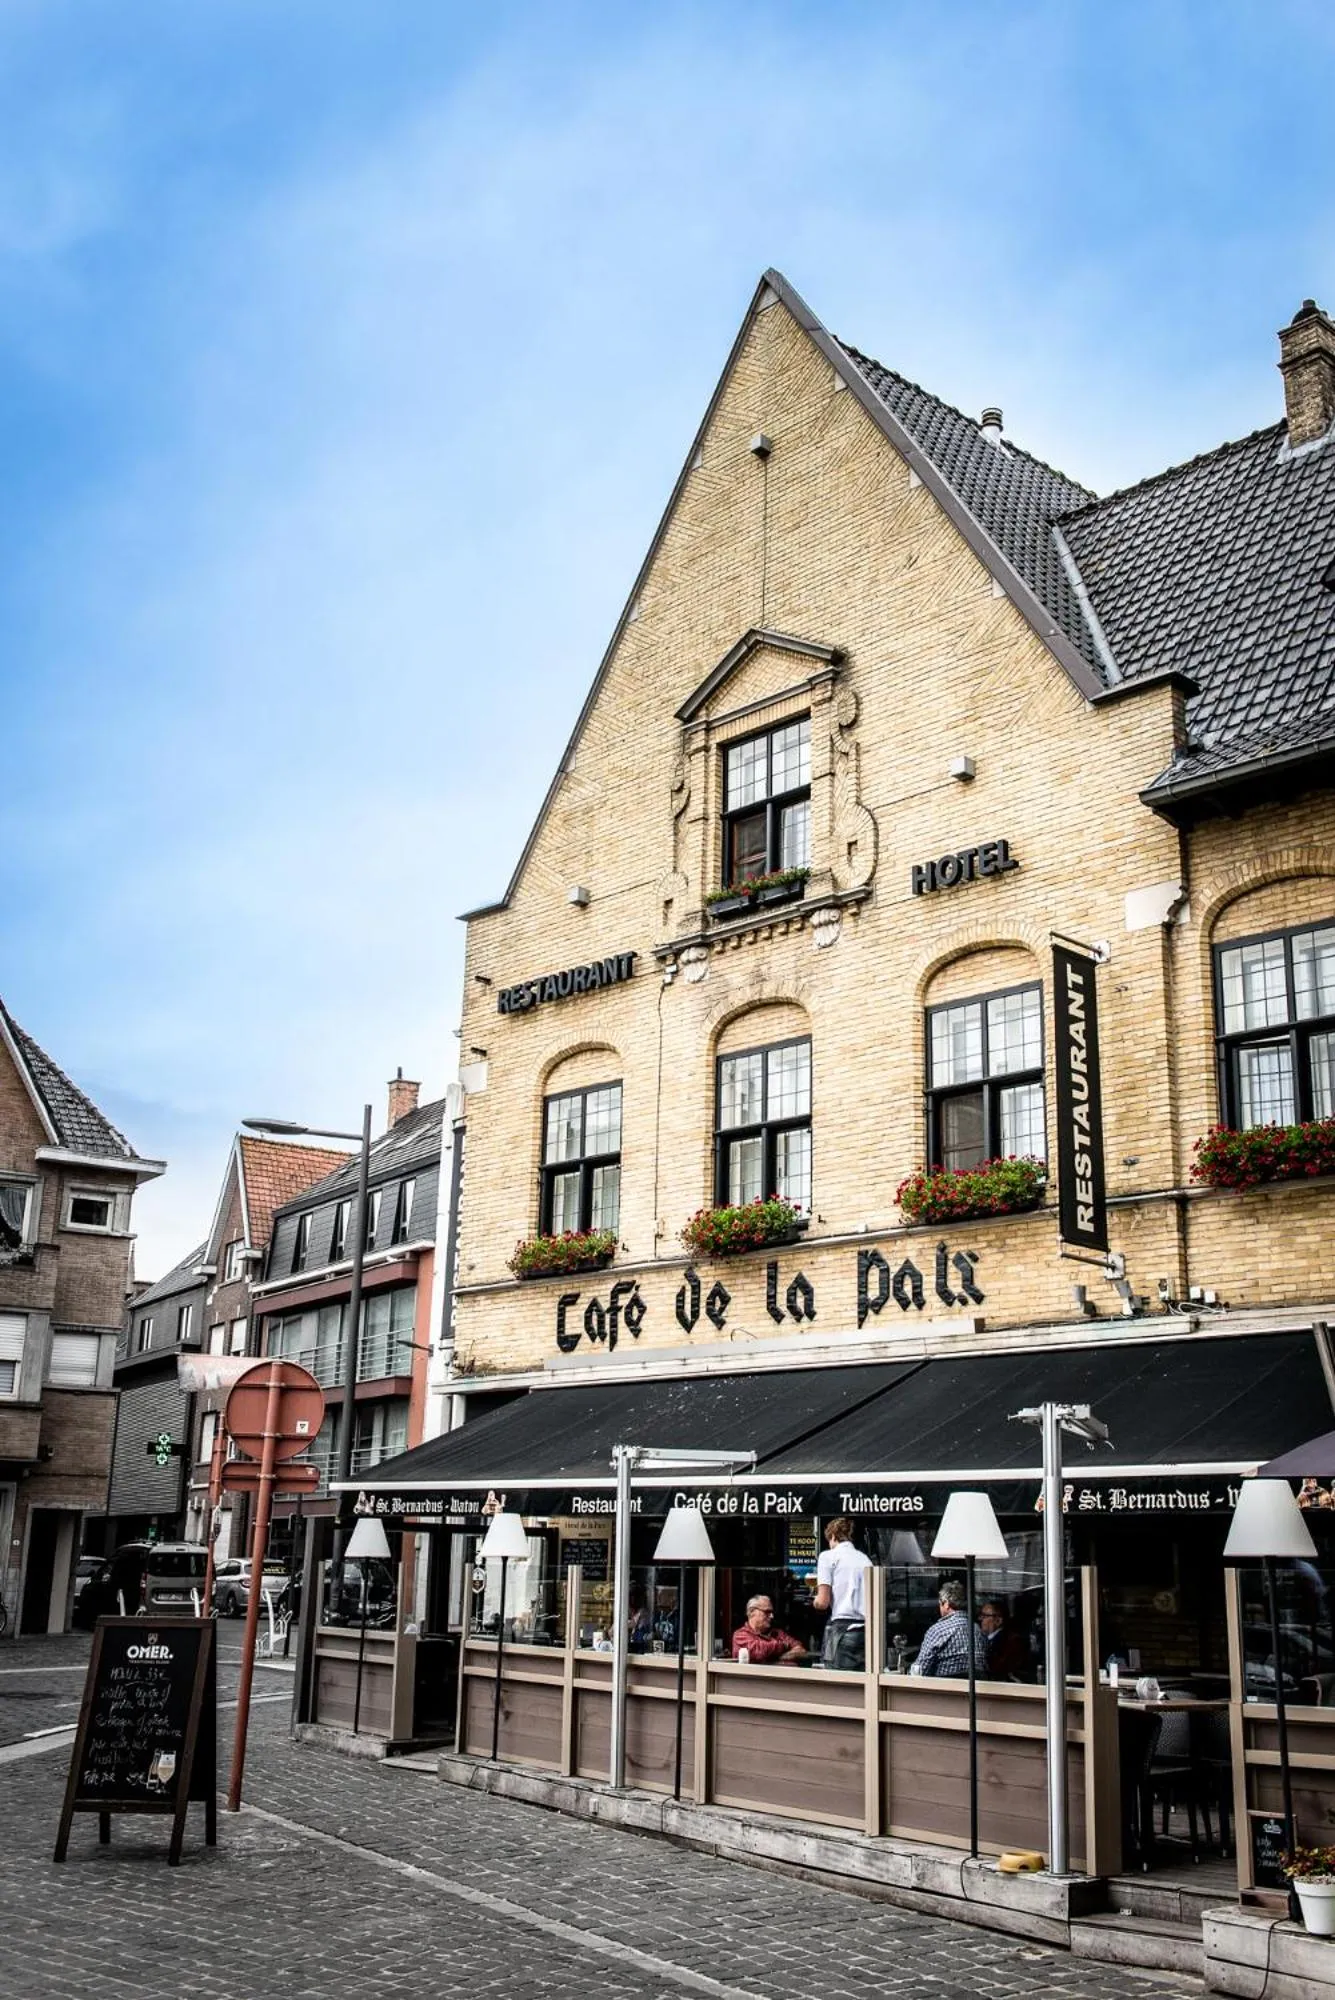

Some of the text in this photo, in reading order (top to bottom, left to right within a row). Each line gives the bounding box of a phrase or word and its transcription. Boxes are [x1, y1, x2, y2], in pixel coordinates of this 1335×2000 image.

[911, 839, 1019, 895] HOTEL
[498, 951, 638, 1014] RESTAURANT
[1066, 962, 1095, 1233] RESTAURANT
[557, 1279, 648, 1353] Café
[676, 1266, 732, 1334] de
[767, 1261, 817, 1326] la
[376, 1498, 390, 1513] St.
[391, 1498, 444, 1514] Bernardus
[572, 1496, 642, 1513] Restaunt
[674, 1491, 803, 1513] Café de la Paix
[839, 1492, 924, 1513] Tuinterras
[1078, 1488, 1107, 1510] St.
[1109, 1485, 1211, 1513] Bernardus
